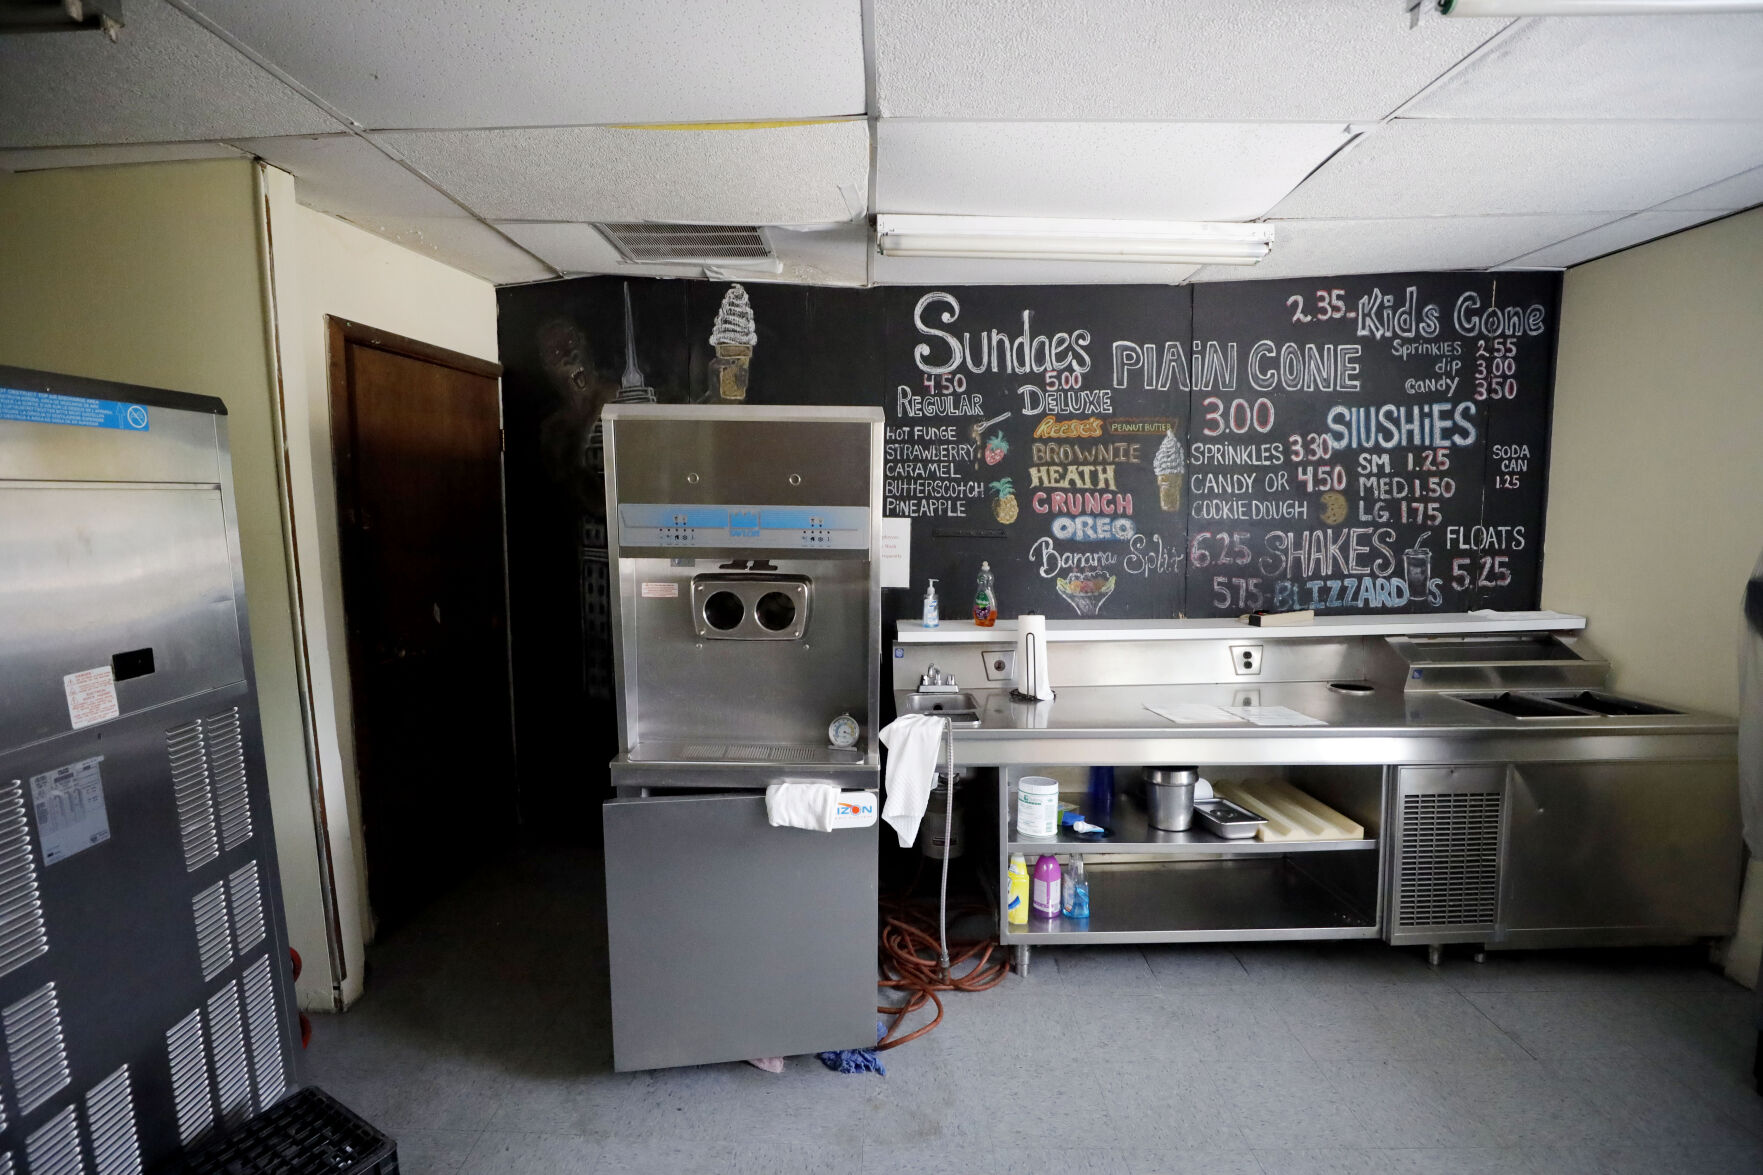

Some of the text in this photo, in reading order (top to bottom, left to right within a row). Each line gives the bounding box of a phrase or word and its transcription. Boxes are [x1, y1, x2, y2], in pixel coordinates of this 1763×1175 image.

[1357, 286, 1440, 340] Kids
[1454, 291, 1545, 337] Cone
[914, 291, 1091, 374] Sundaes
[1249, 340, 1362, 392] CONE
[1435, 358, 1462, 376] dip
[923, 373, 967, 395] 4.50
[1045, 371, 1082, 391] 5.00
[897, 385, 984, 417] REGULAR
[1017, 384, 1113, 415] DELUXE
[1034, 416, 1172, 438] Reese's PEANUT BUTTER
[1202, 396, 1275, 436] 3.00
[886, 426, 957, 440] HOT FUDGE
[886, 443, 977, 461] STRAWBERRY
[1032, 442, 1141, 464] BROWNIE
[1289, 433, 1332, 462] 3.30
[1492, 445, 1530, 459] SODA
[885, 462, 962, 478] CARAMEL
[1357, 448, 1450, 474] SM. 1.25
[1501, 459, 1528, 472] CAN
[1029, 465, 1118, 491] HEATH
[1191, 465, 1347, 494] CANDY OR 4.50
[1358, 476, 1456, 499] MED. 1.50
[1495, 475, 1520, 489] 1.25
[1032, 491, 1133, 516] CRUNCH
[1252, 500, 1308, 520] DOUGH
[1358, 500, 1443, 526] LG. 1.75
[1052, 515, 1136, 541] OREO
[1446, 525, 1525, 550] FLOATS
[1029, 534, 1185, 578] Banana Split
[1190, 527, 1397, 579] 6.25 SHAKES
[1451, 556, 1512, 592] 5.25
